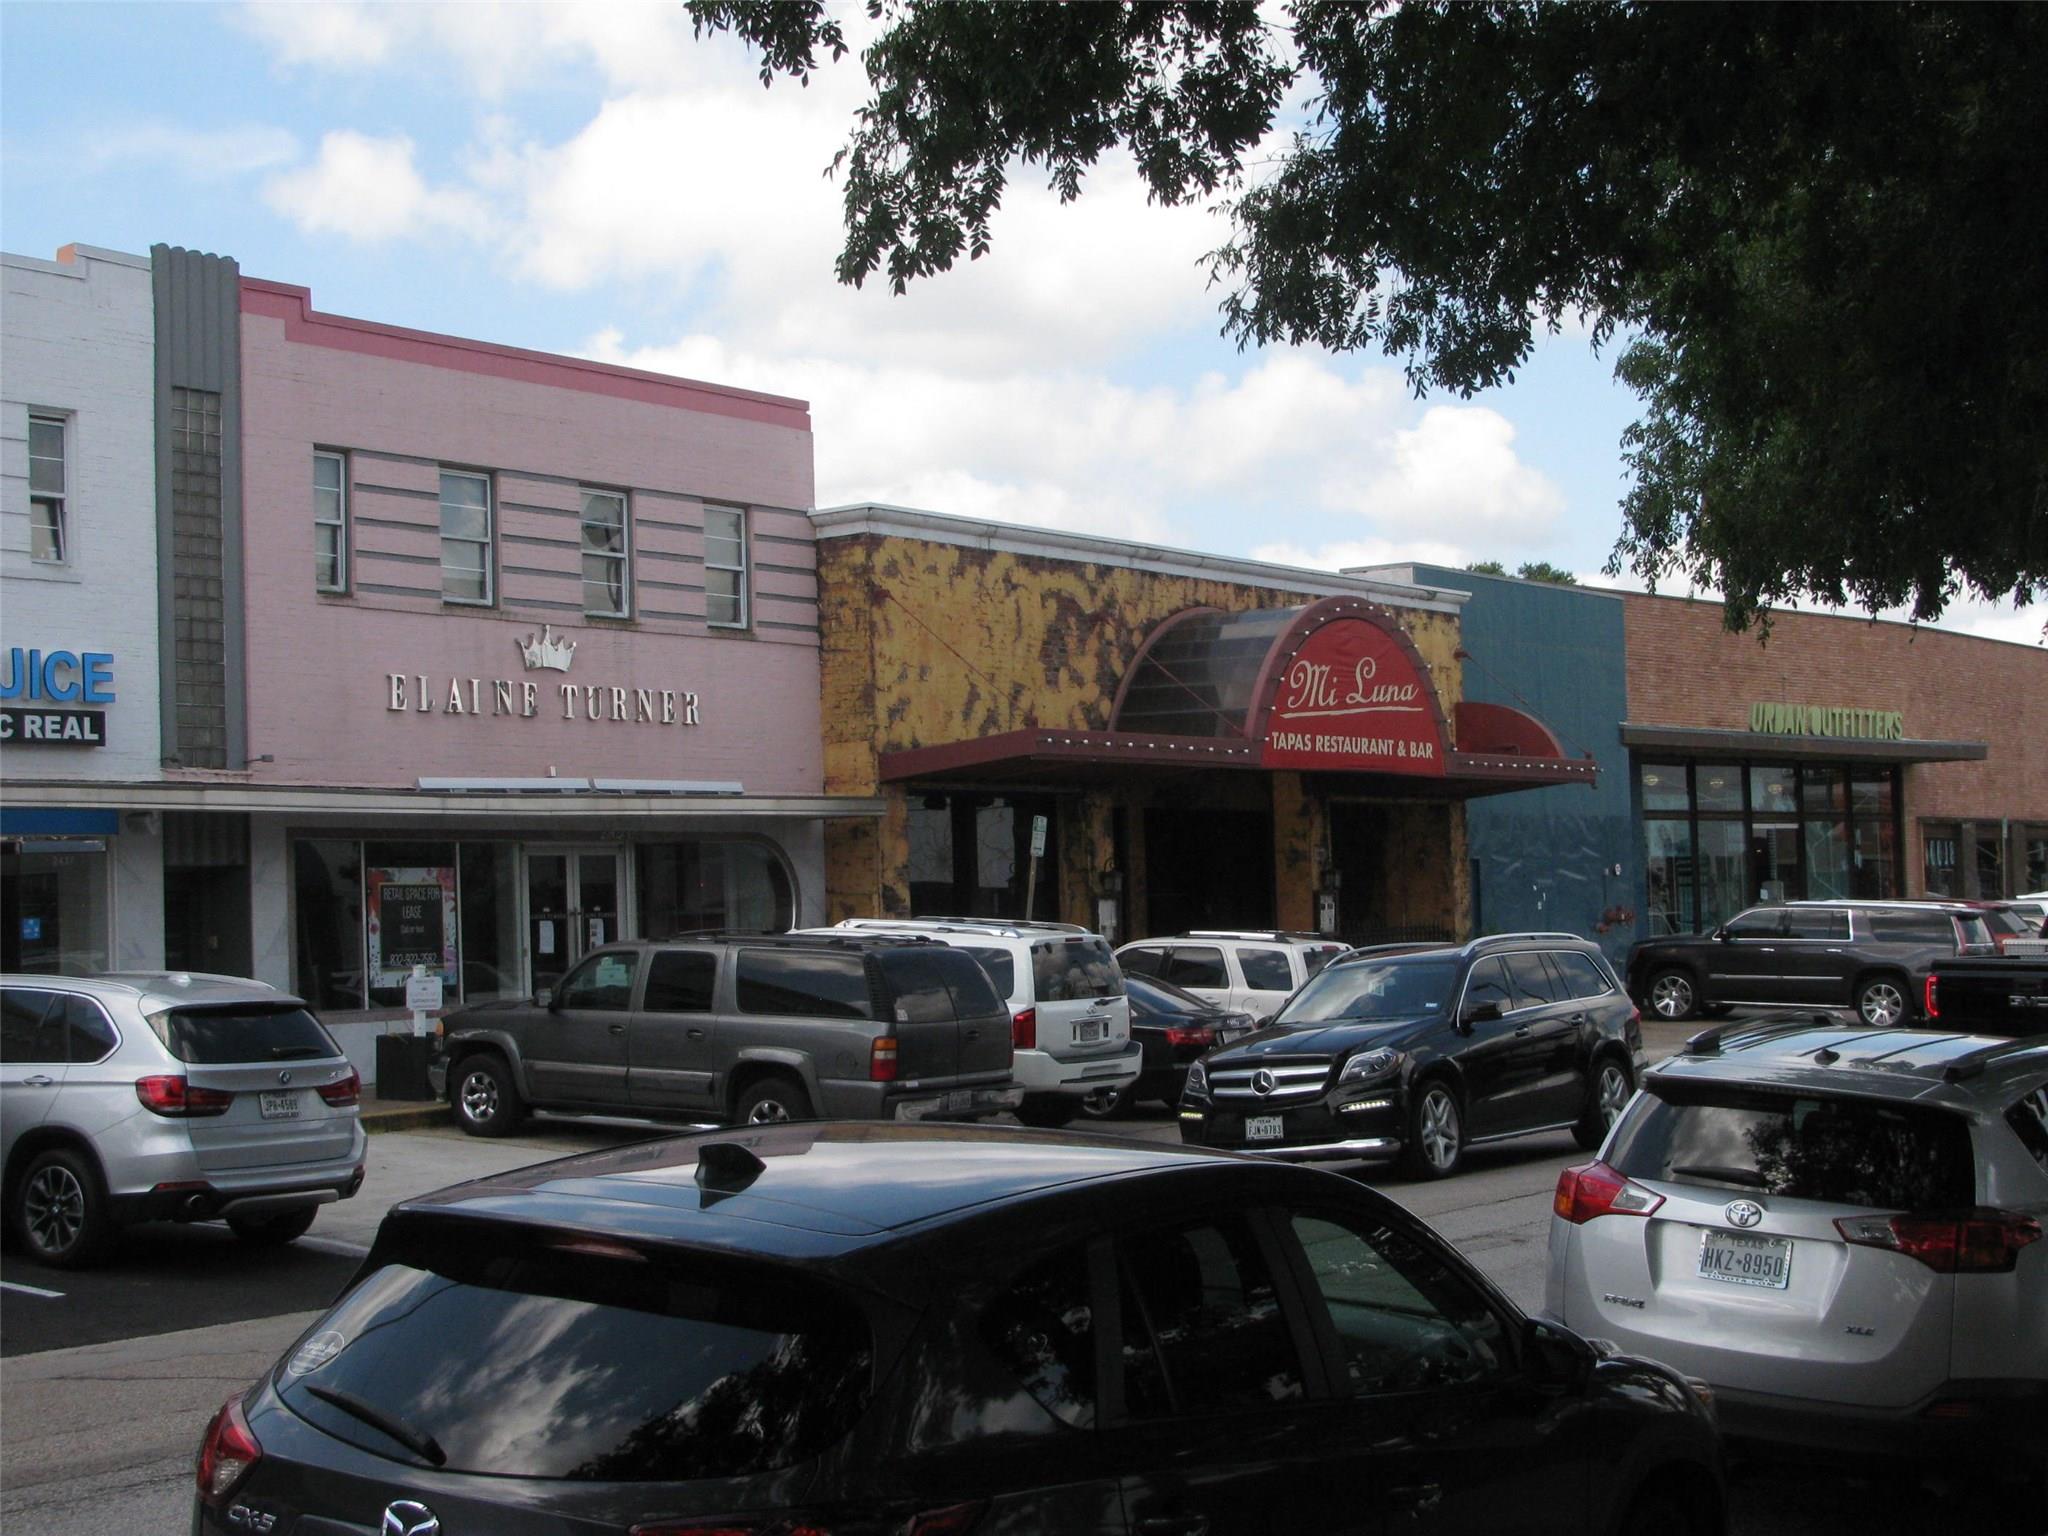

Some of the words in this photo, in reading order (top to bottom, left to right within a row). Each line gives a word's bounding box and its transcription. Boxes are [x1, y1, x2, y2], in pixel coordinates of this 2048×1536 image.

[1287, 660, 1338, 708] Mi
[1345, 656, 1419, 704] Luna
[387, 674, 538, 717] ELAINE
[560, 683, 701, 726] TURNER
[24, 714, 100, 740] REAL
[1750, 702, 1807, 735] URBAN
[1808, 706, 1904, 740] OUTFITTERS
[1272, 731, 1312, 751] TAPAS
[1315, 735, 1394, 756] RESTAURANT
[1397, 741, 1407, 757] &
[1409, 742, 1434, 759] BAR
[405, 887, 427, 901] SPACE
[427, 888, 441, 901] FOR
[402, 905, 423, 919] LEASE
[1732, 1239, 1764, 1250] TEXAS
[1845, 1325, 1876, 1336] XLE
[229, 1504, 277, 1531] CX-5
